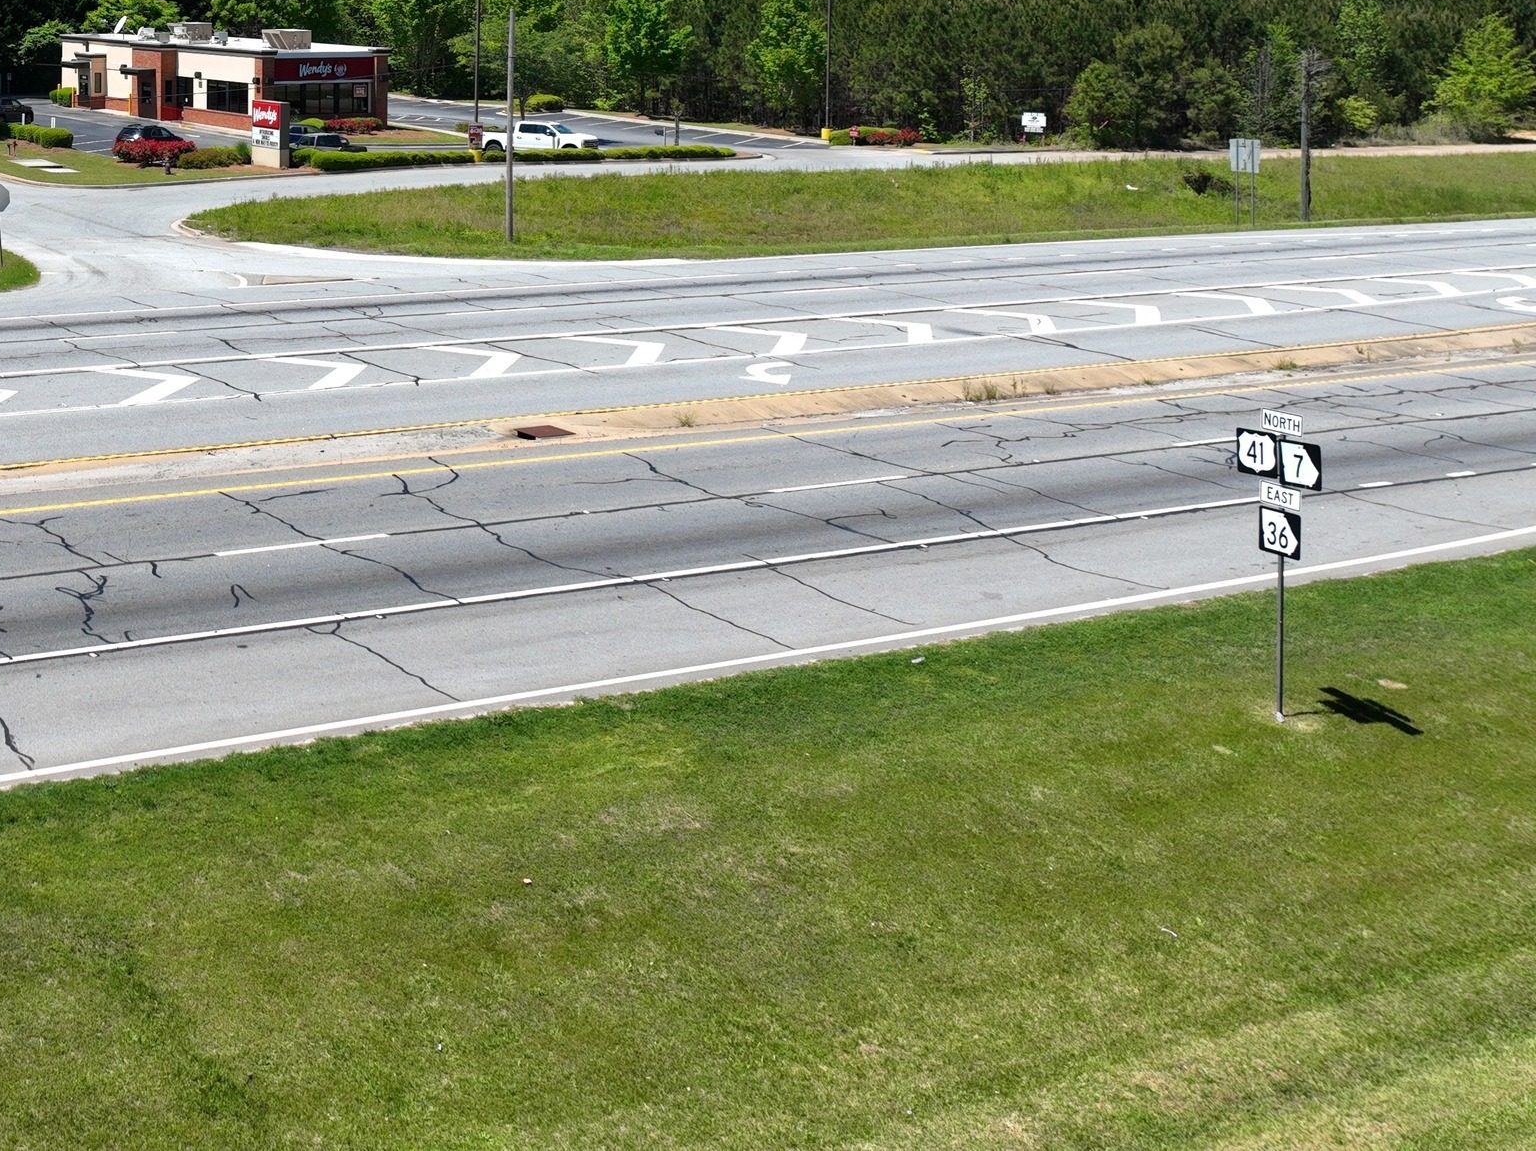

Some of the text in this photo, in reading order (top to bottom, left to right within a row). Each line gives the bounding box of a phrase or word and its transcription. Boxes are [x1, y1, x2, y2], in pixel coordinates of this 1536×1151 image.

[299, 61, 332, 77] Wendy's
[253, 106, 277, 124] Wendy's
[1264, 412, 1300, 433] NORTH
[1247, 440, 1264, 465] 41
[1293, 454, 1303, 478] 7
[1267, 486, 1294, 506] EAST
[1267, 521, 1289, 549] 36
